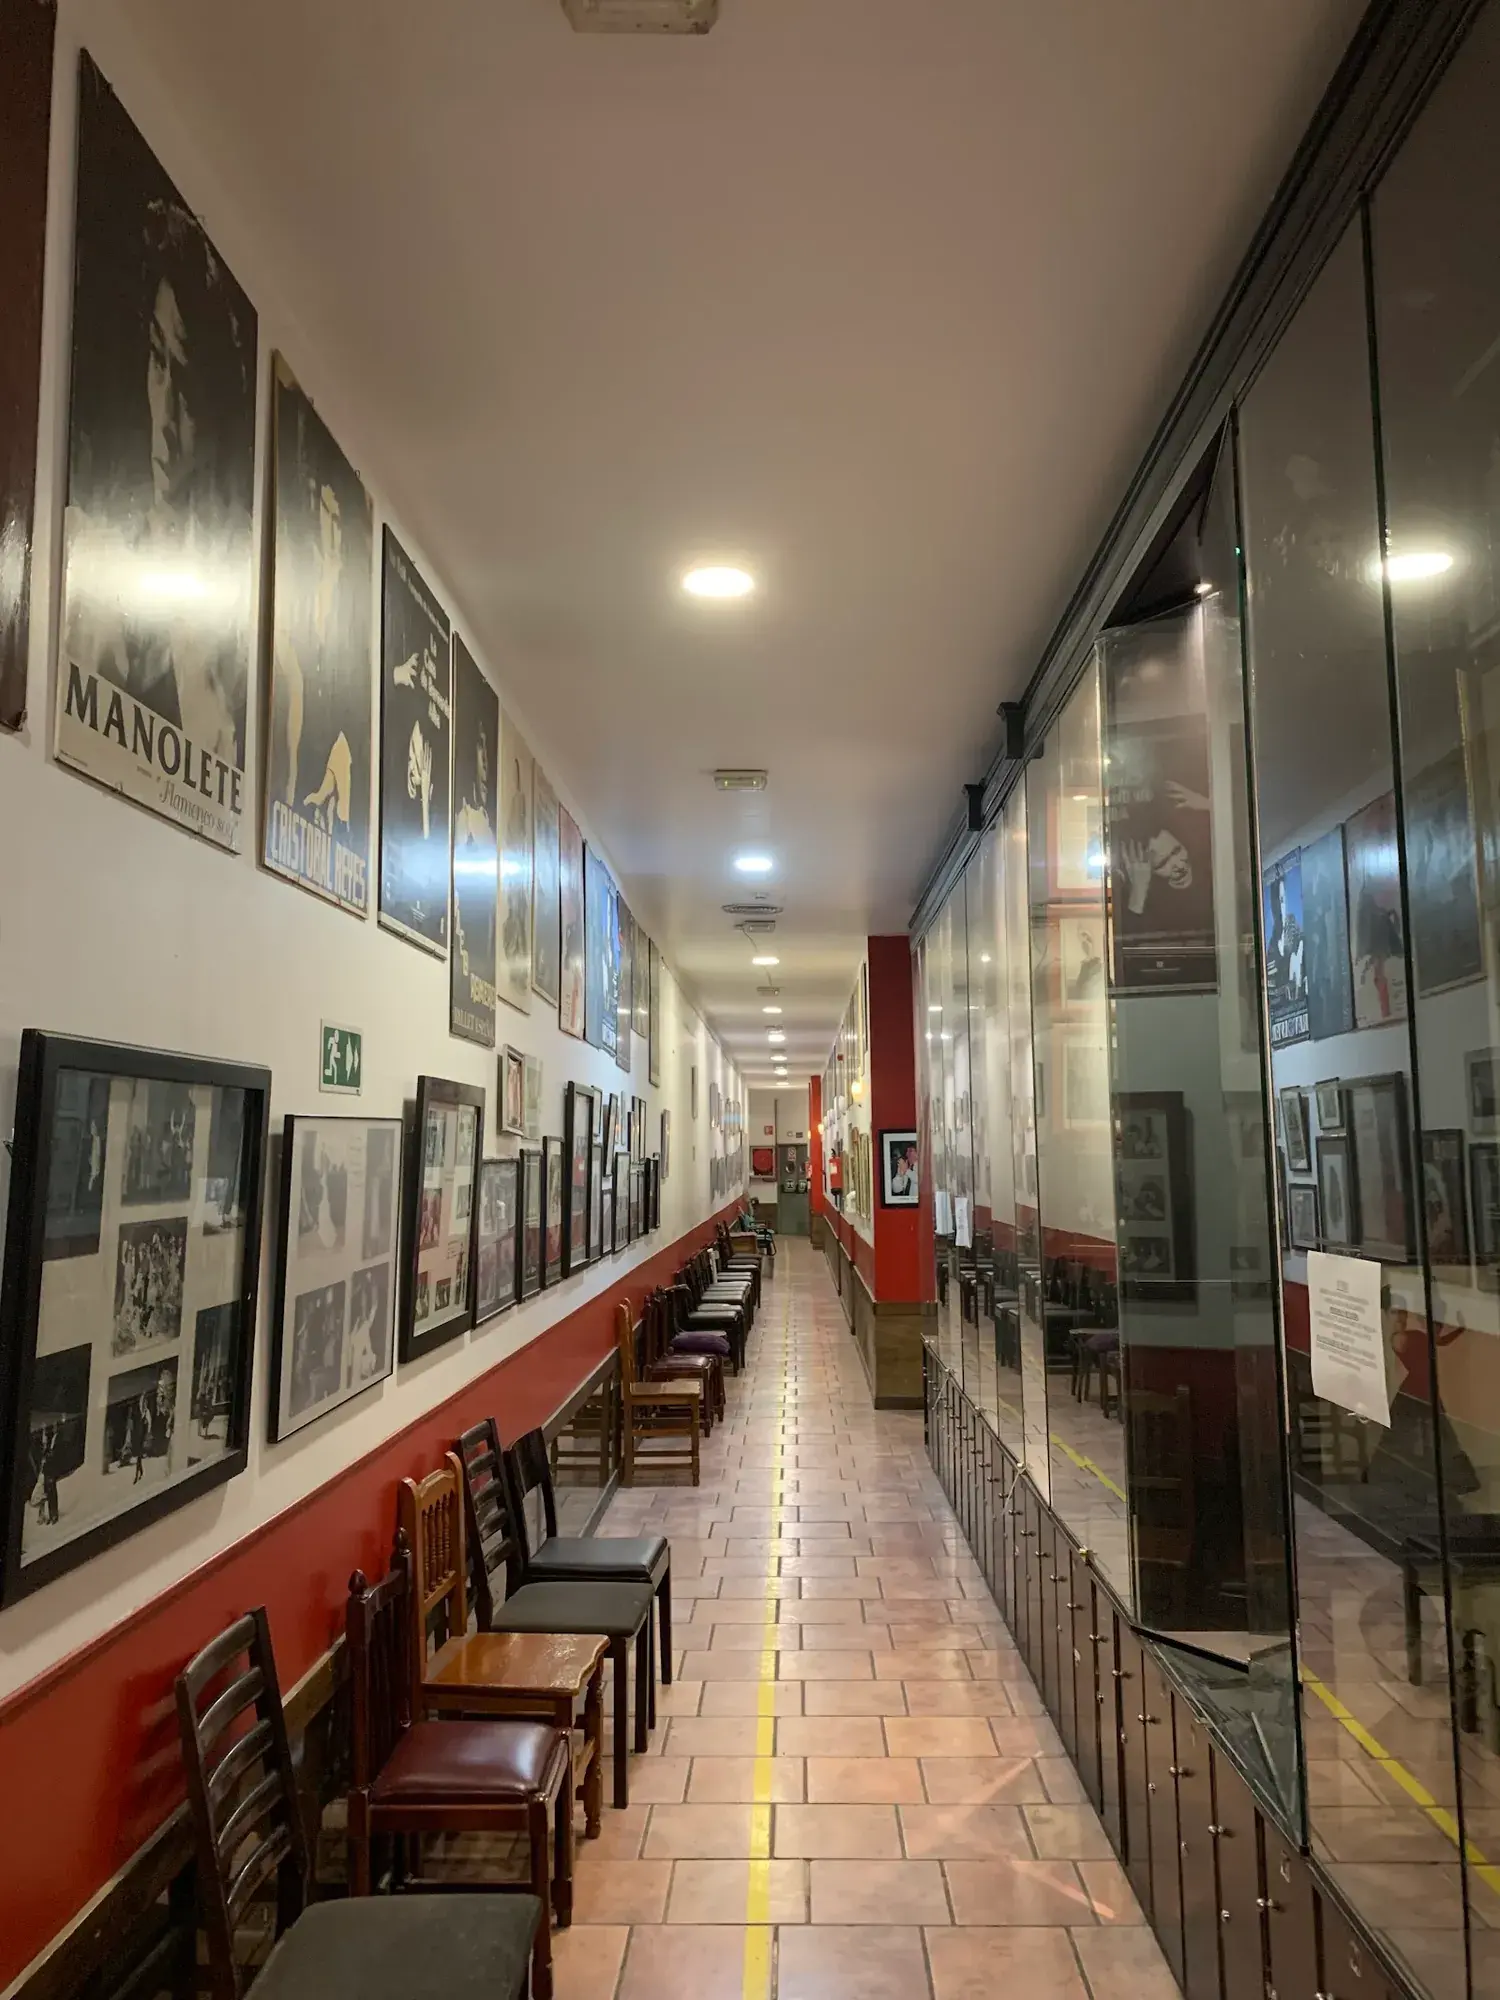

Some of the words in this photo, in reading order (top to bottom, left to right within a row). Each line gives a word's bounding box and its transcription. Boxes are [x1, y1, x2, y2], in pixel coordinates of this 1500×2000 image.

[64, 661, 242, 815] MANOLETE
[271, 799, 333, 891] CRISTOBAL
[334, 840, 367, 909] REYES
